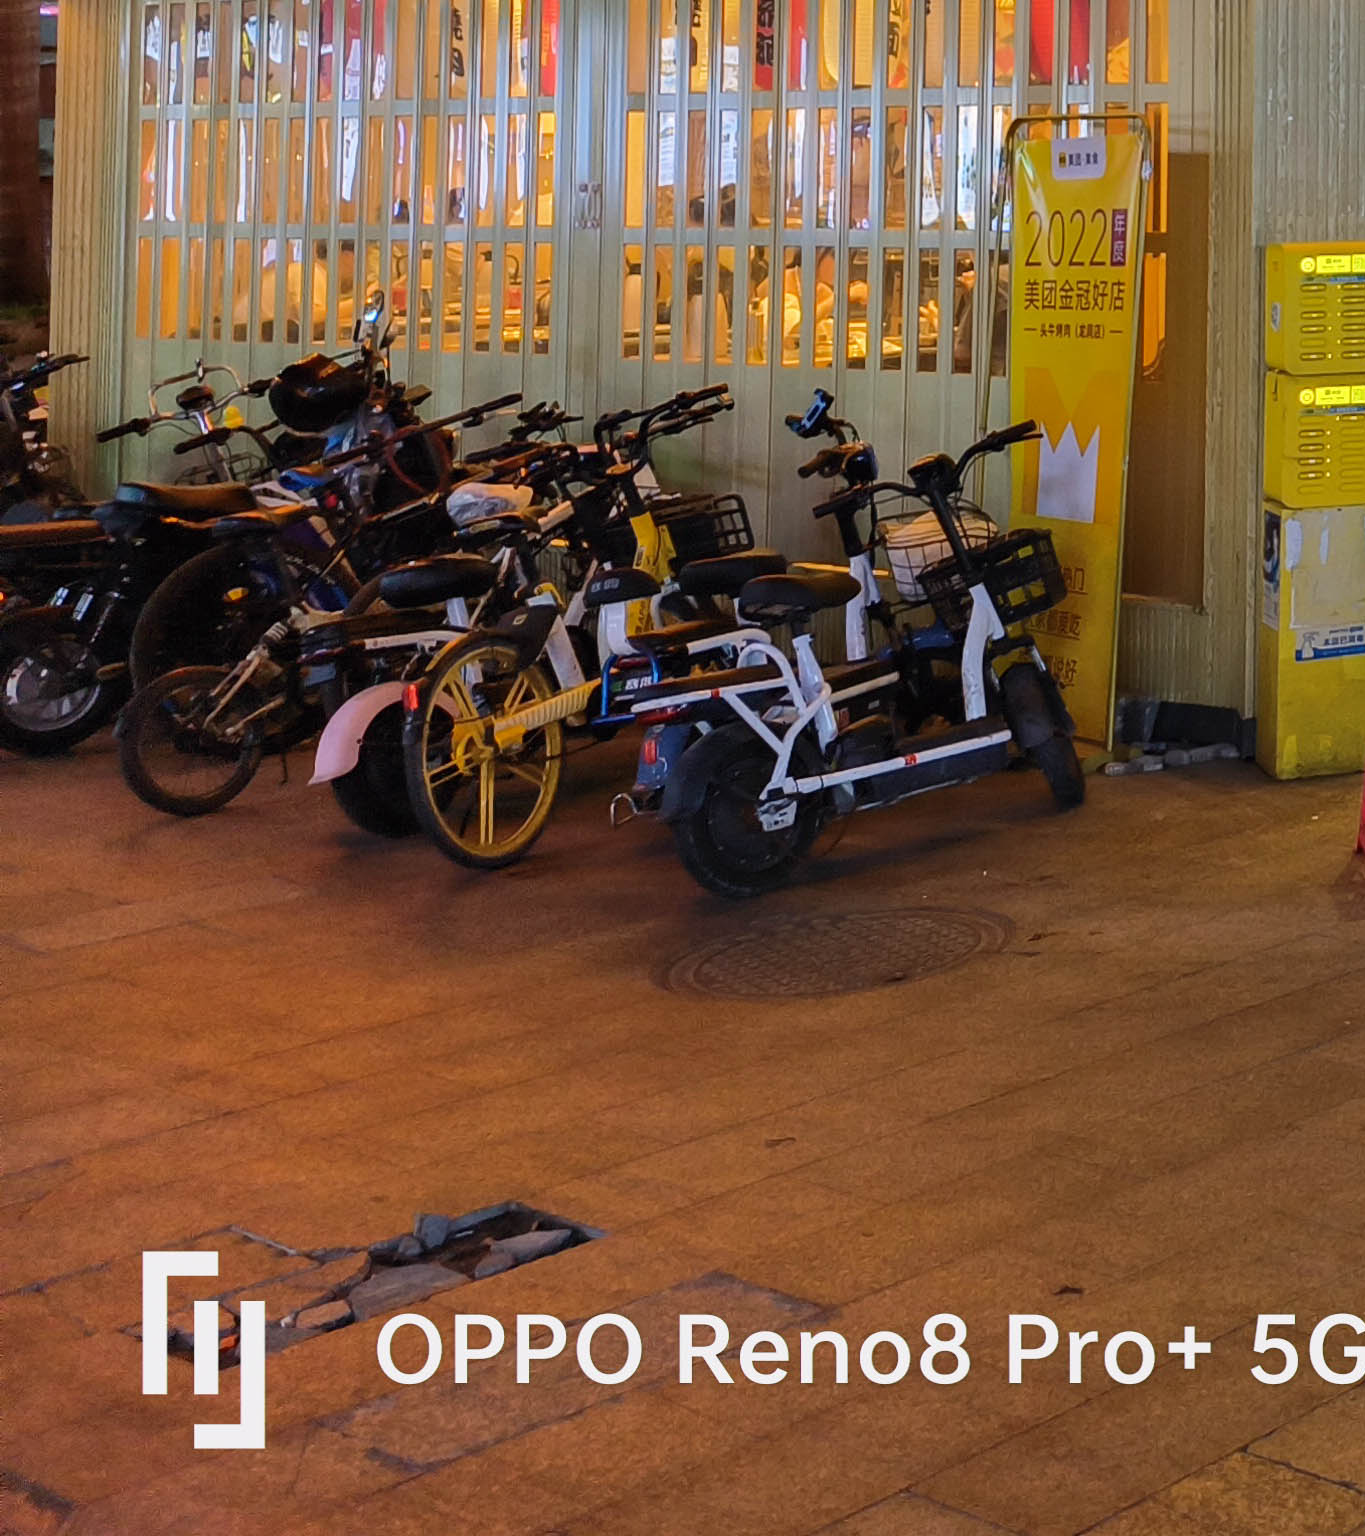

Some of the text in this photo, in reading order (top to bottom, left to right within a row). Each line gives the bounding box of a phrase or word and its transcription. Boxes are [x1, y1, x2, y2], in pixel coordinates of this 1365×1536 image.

[1024, 208, 1108, 267] 2022
[1112, 213, 1127, 264] 年度
[1023, 279, 1126, 312] 美团金冠好店
